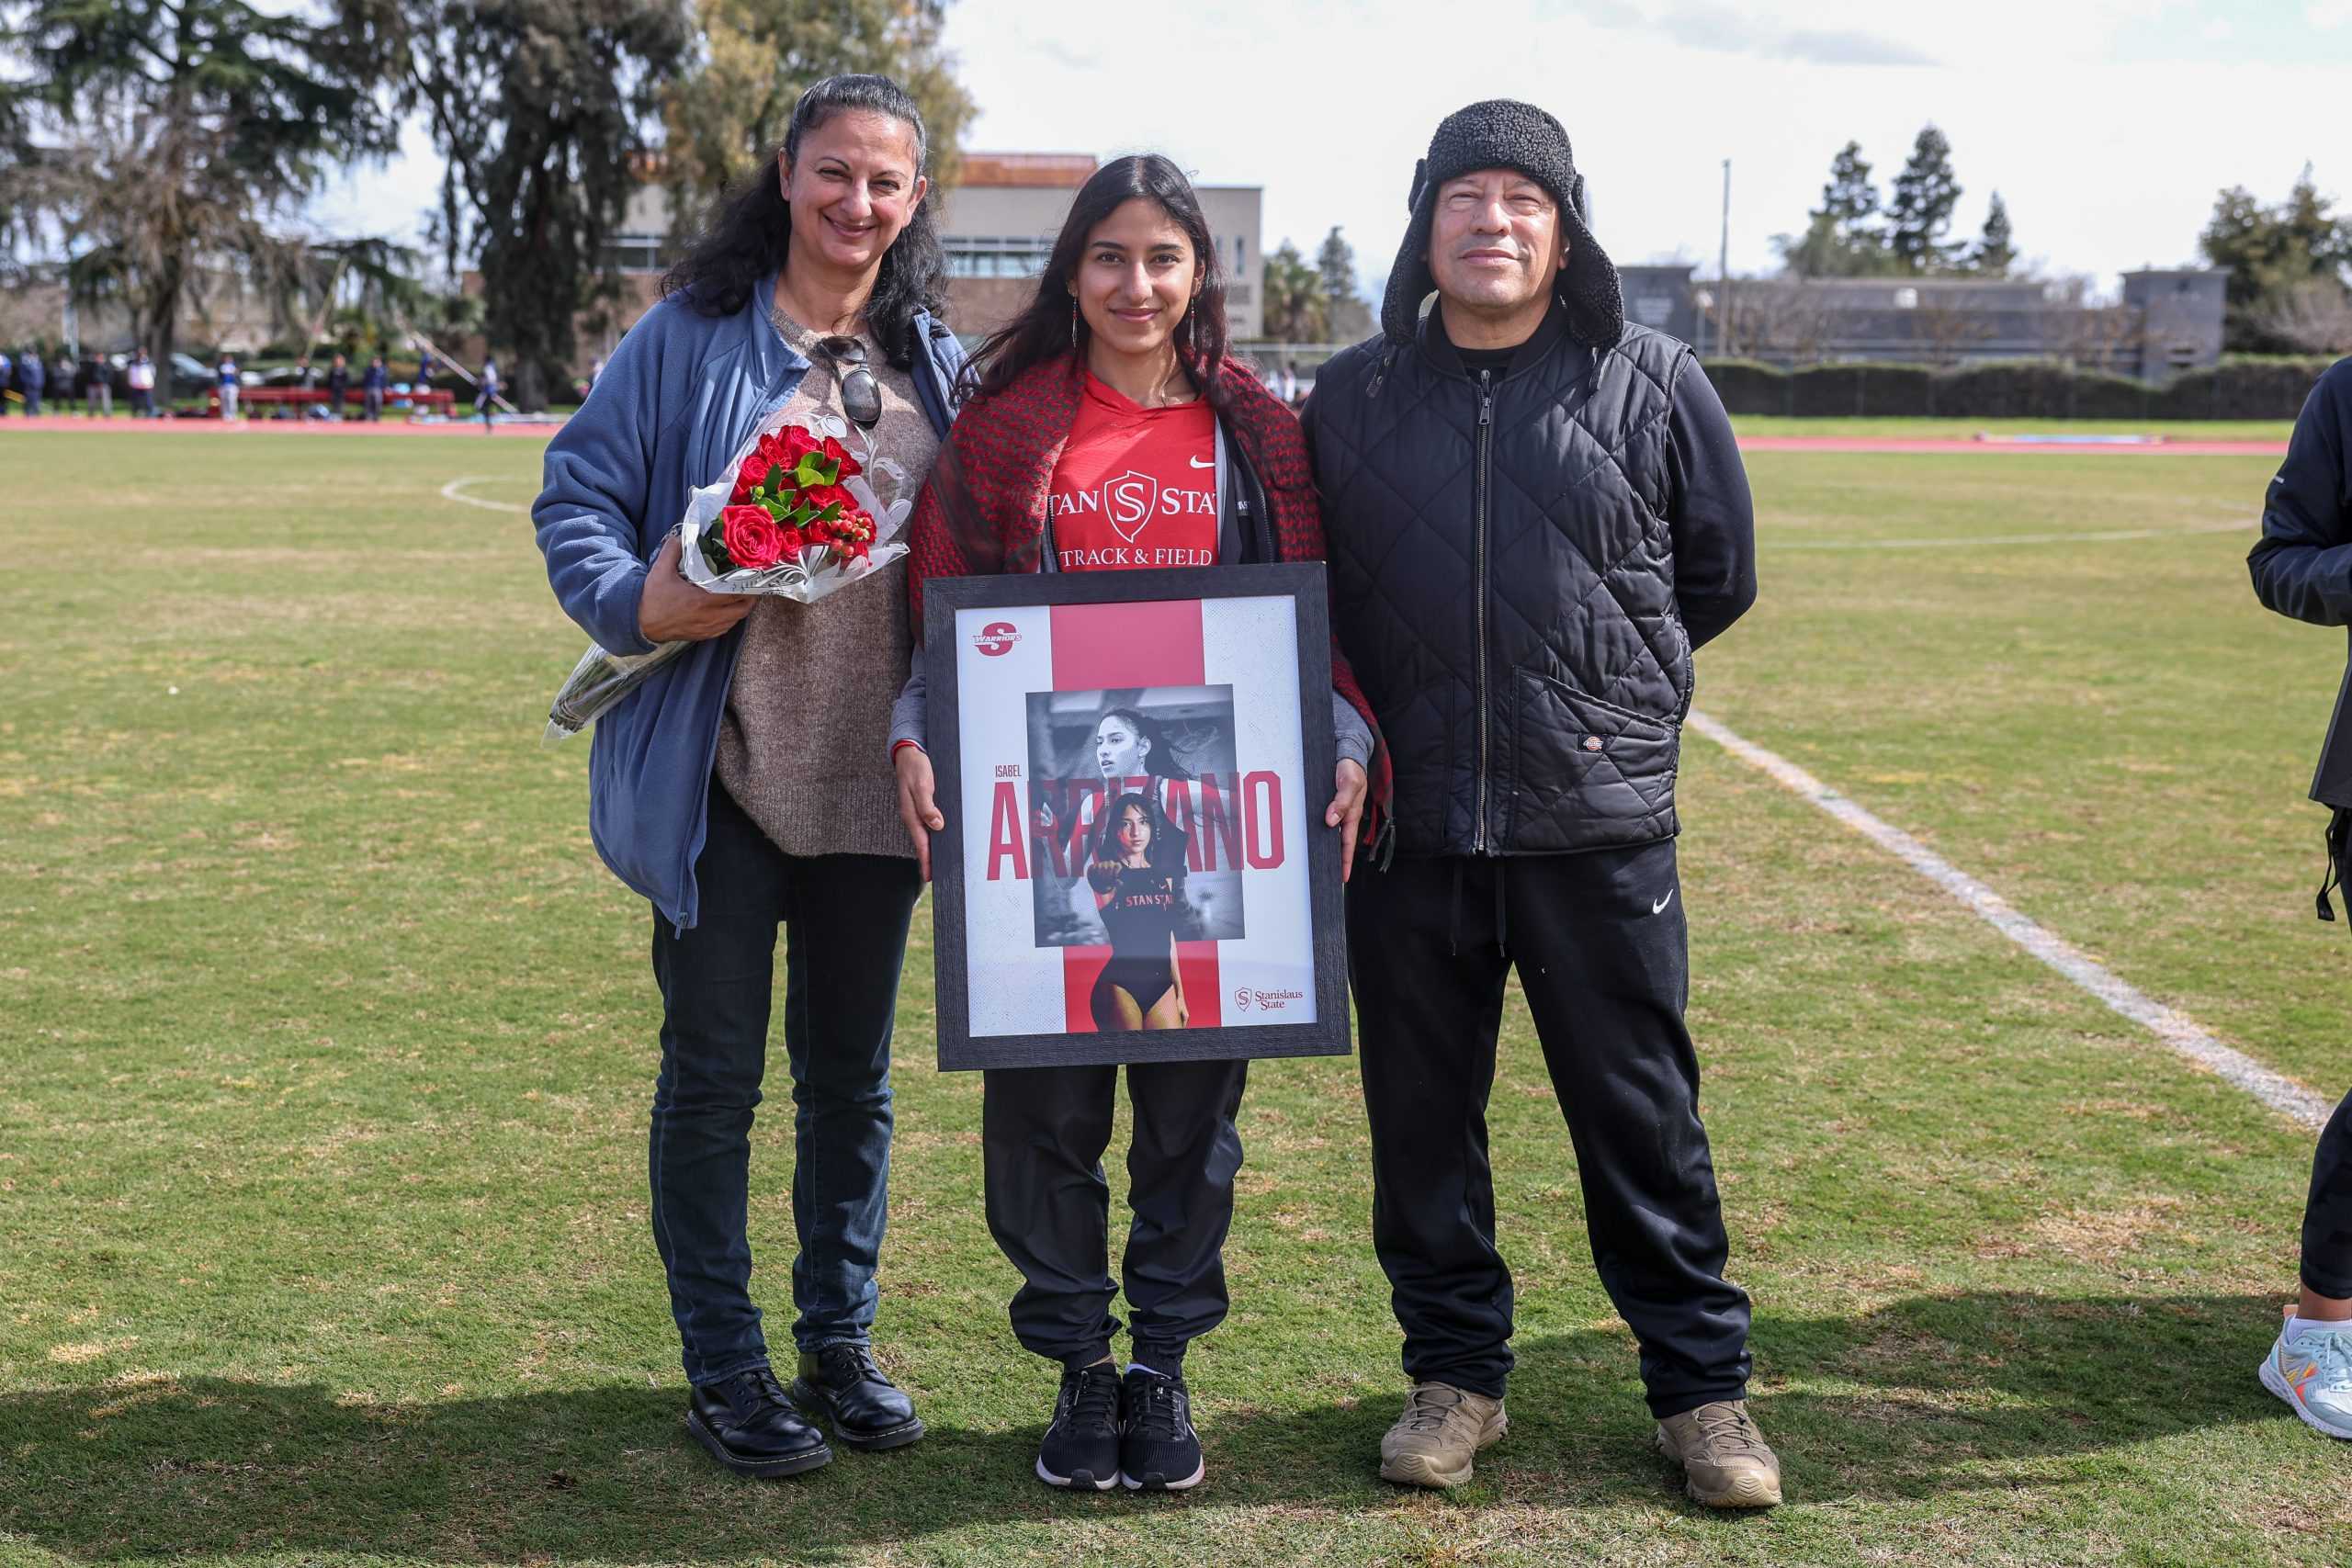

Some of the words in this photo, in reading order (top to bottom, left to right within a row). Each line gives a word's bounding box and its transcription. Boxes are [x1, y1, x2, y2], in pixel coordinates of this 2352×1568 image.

[1161, 488, 1216, 514] STA
[1059, 547, 1127, 567] TRACK
[1135, 550, 1148, 565] &
[1155, 548, 1213, 566] FIELD
[995, 764, 1022, 778] ISABEL
[987, 770, 1284, 881] ARRANO
[1125, 895, 1153, 907] STAN
[1255, 989, 1304, 1002] Stanislaus
[1261, 1000, 1285, 1011] State
